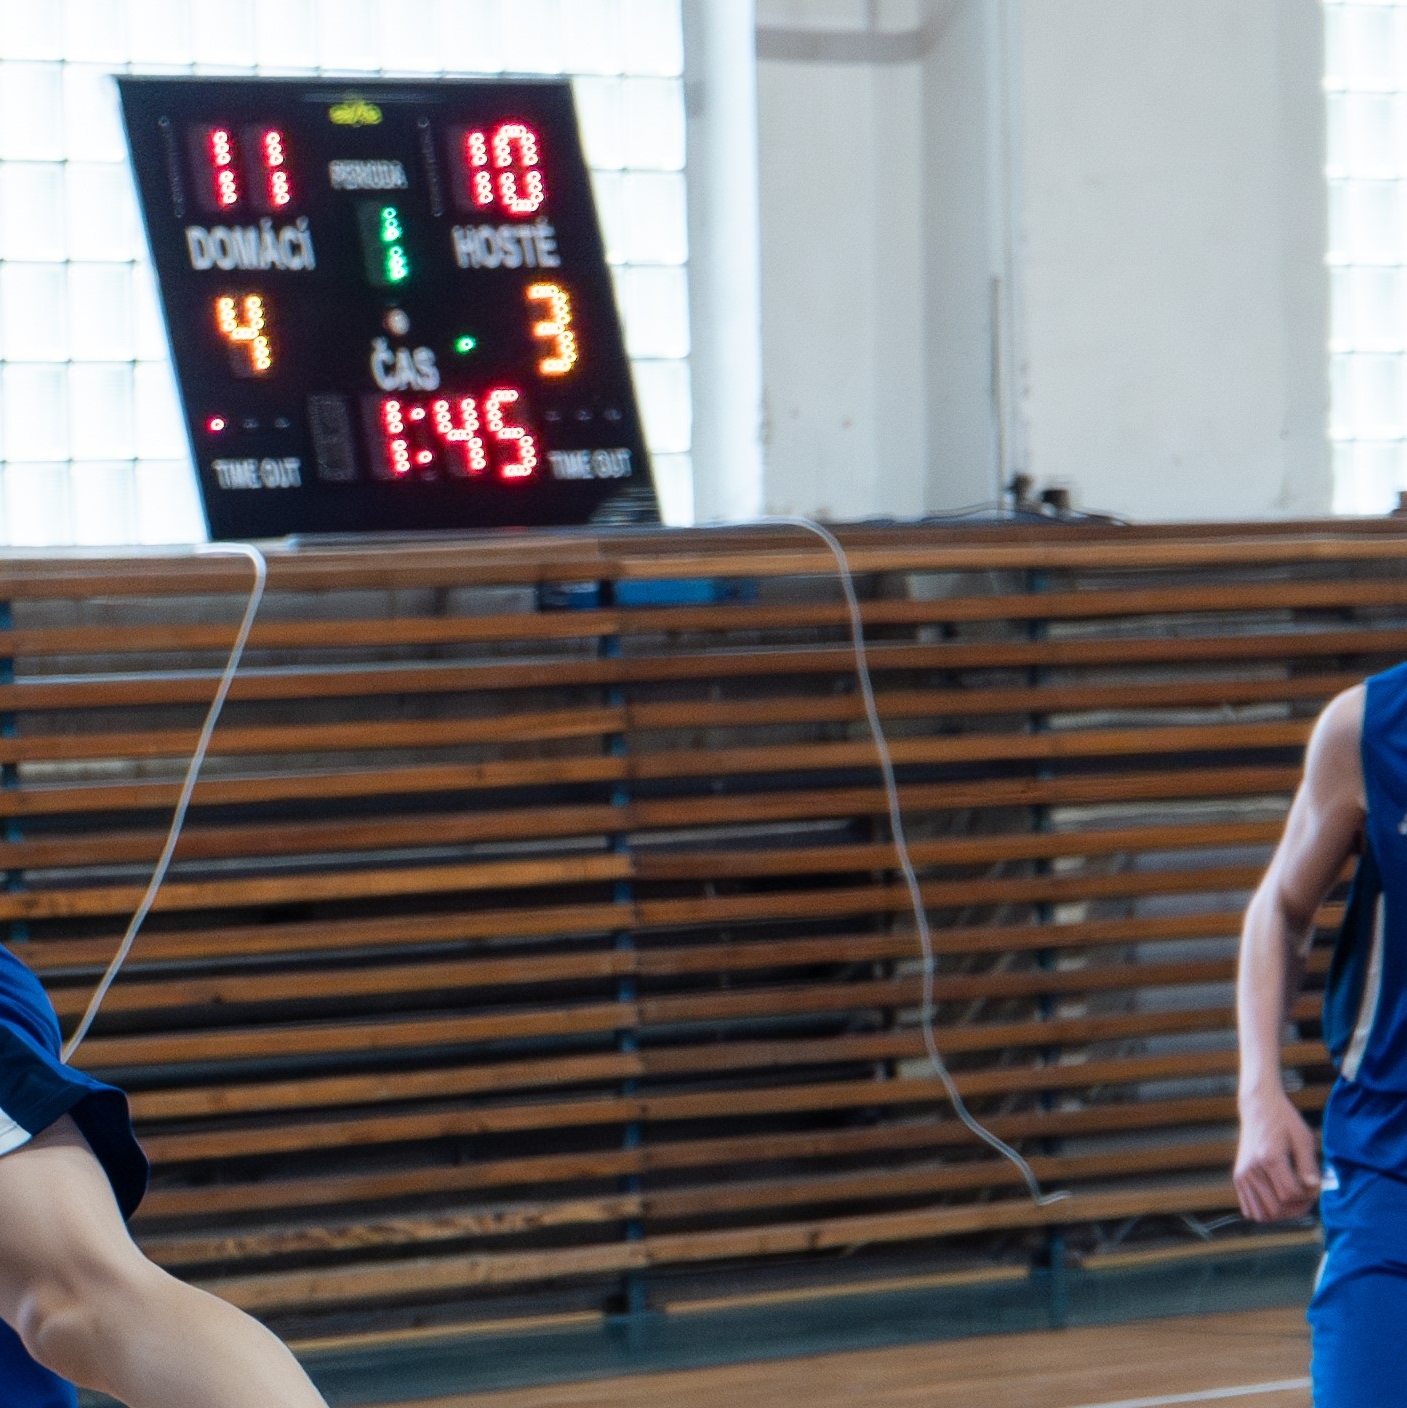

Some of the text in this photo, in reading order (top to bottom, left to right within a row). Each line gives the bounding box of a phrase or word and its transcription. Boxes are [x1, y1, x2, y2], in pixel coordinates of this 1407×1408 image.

[211, 130, 291, 207] 11
[466, 123, 545, 214] 10
[186, 216, 317, 270] DOMÁCÍ
[214, 294, 272, 372] 4
[525, 283, 578, 377] 3
[371, 336, 441, 391] ČAS
[211, 456, 302, 490] TIME OUT
[546, 448, 632, 480] TIME OUT
